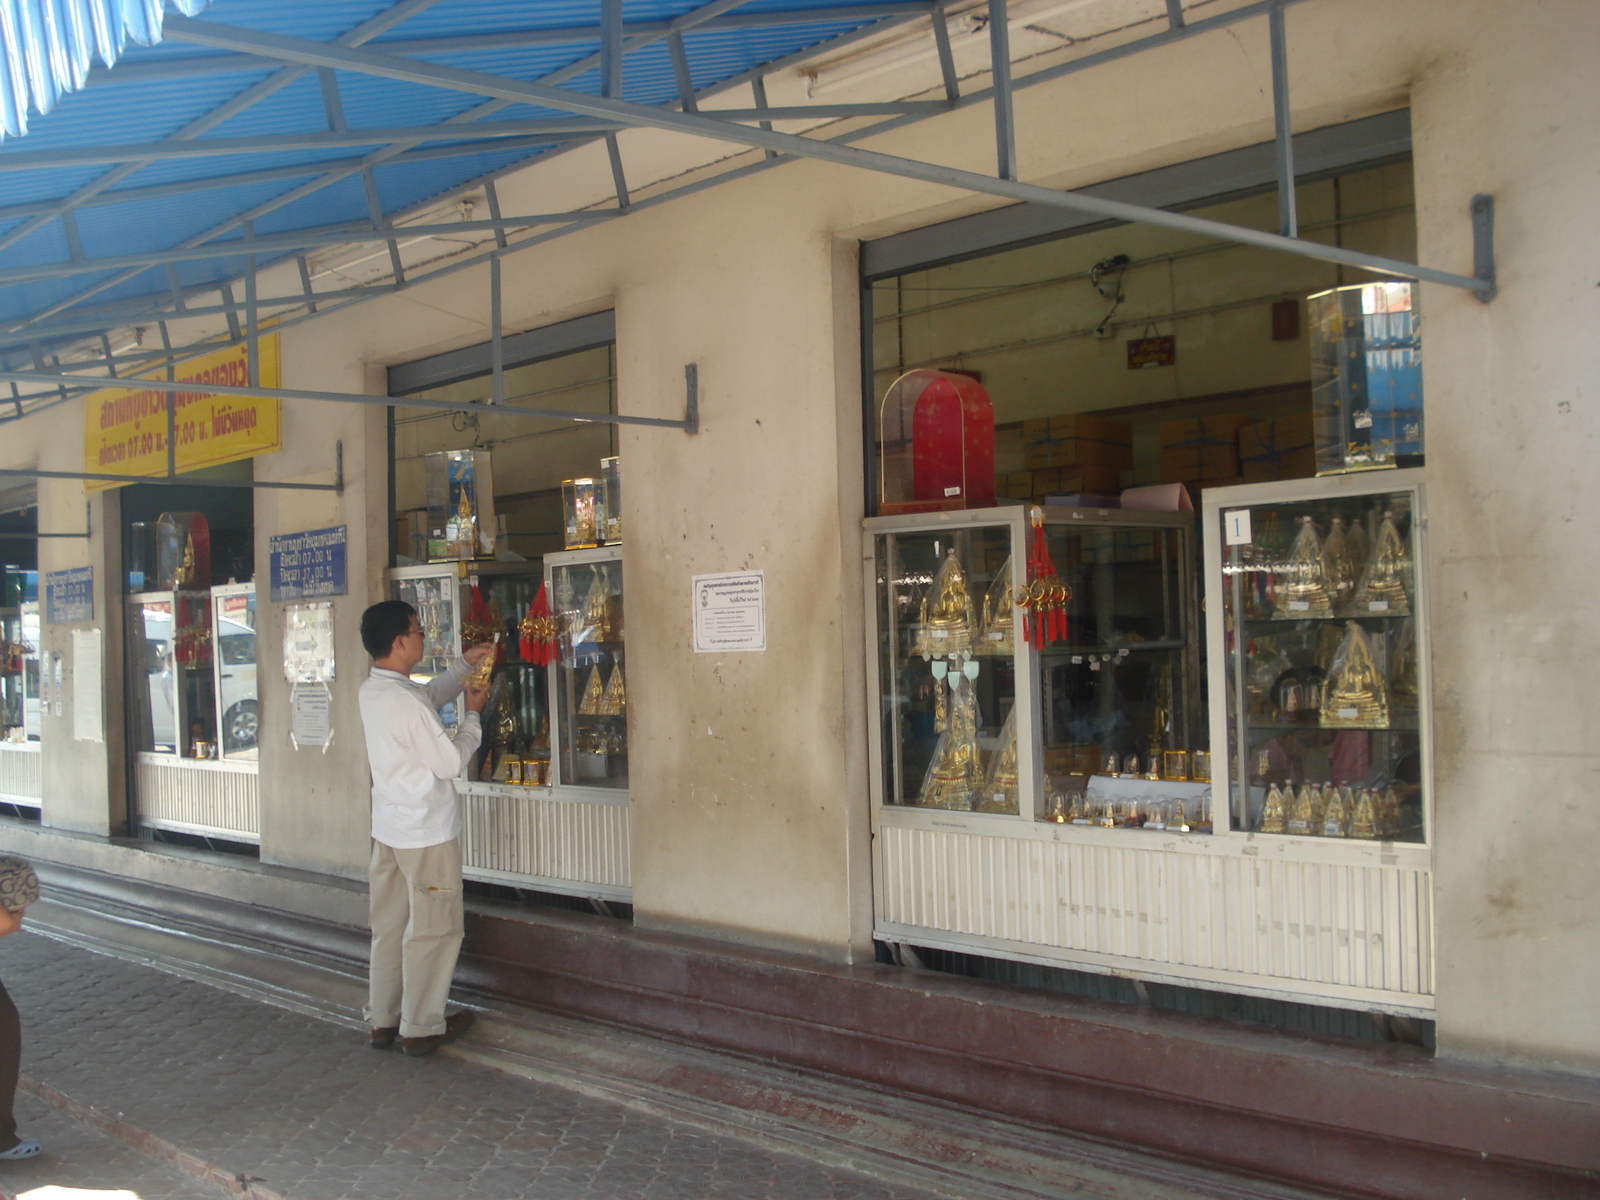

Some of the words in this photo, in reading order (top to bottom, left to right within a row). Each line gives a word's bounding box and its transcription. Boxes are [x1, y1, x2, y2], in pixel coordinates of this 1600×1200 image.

[128, 432, 153, 458] 07.00
[1235, 518, 1240, 537] 1
[303, 550, 324, 564] 07.00
